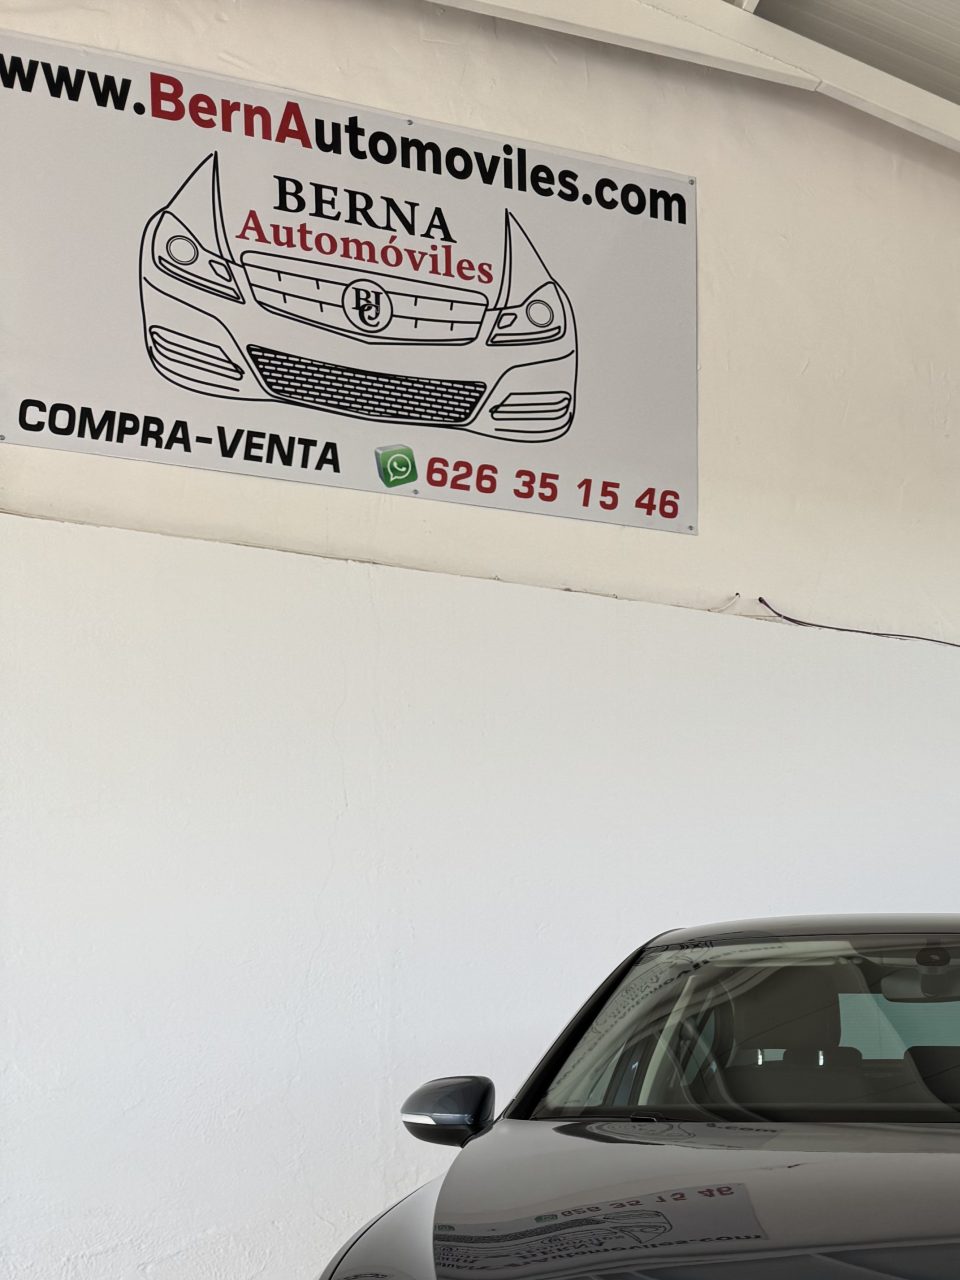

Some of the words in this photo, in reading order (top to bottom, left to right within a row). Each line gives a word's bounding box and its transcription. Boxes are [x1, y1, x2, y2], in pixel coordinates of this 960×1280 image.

[0, 53, 688, 225] www.BernAutomoviles.com
[236, 209, 494, 284] Automóviles
[273, 174, 457, 244] BERNA
[18, 398, 341, 474] COMPRA-VENTA
[426, 457, 498, 494] 626
[513, 469, 560, 502] 35
[577, 478, 620, 511] 15
[634, 487, 680, 519] 46
